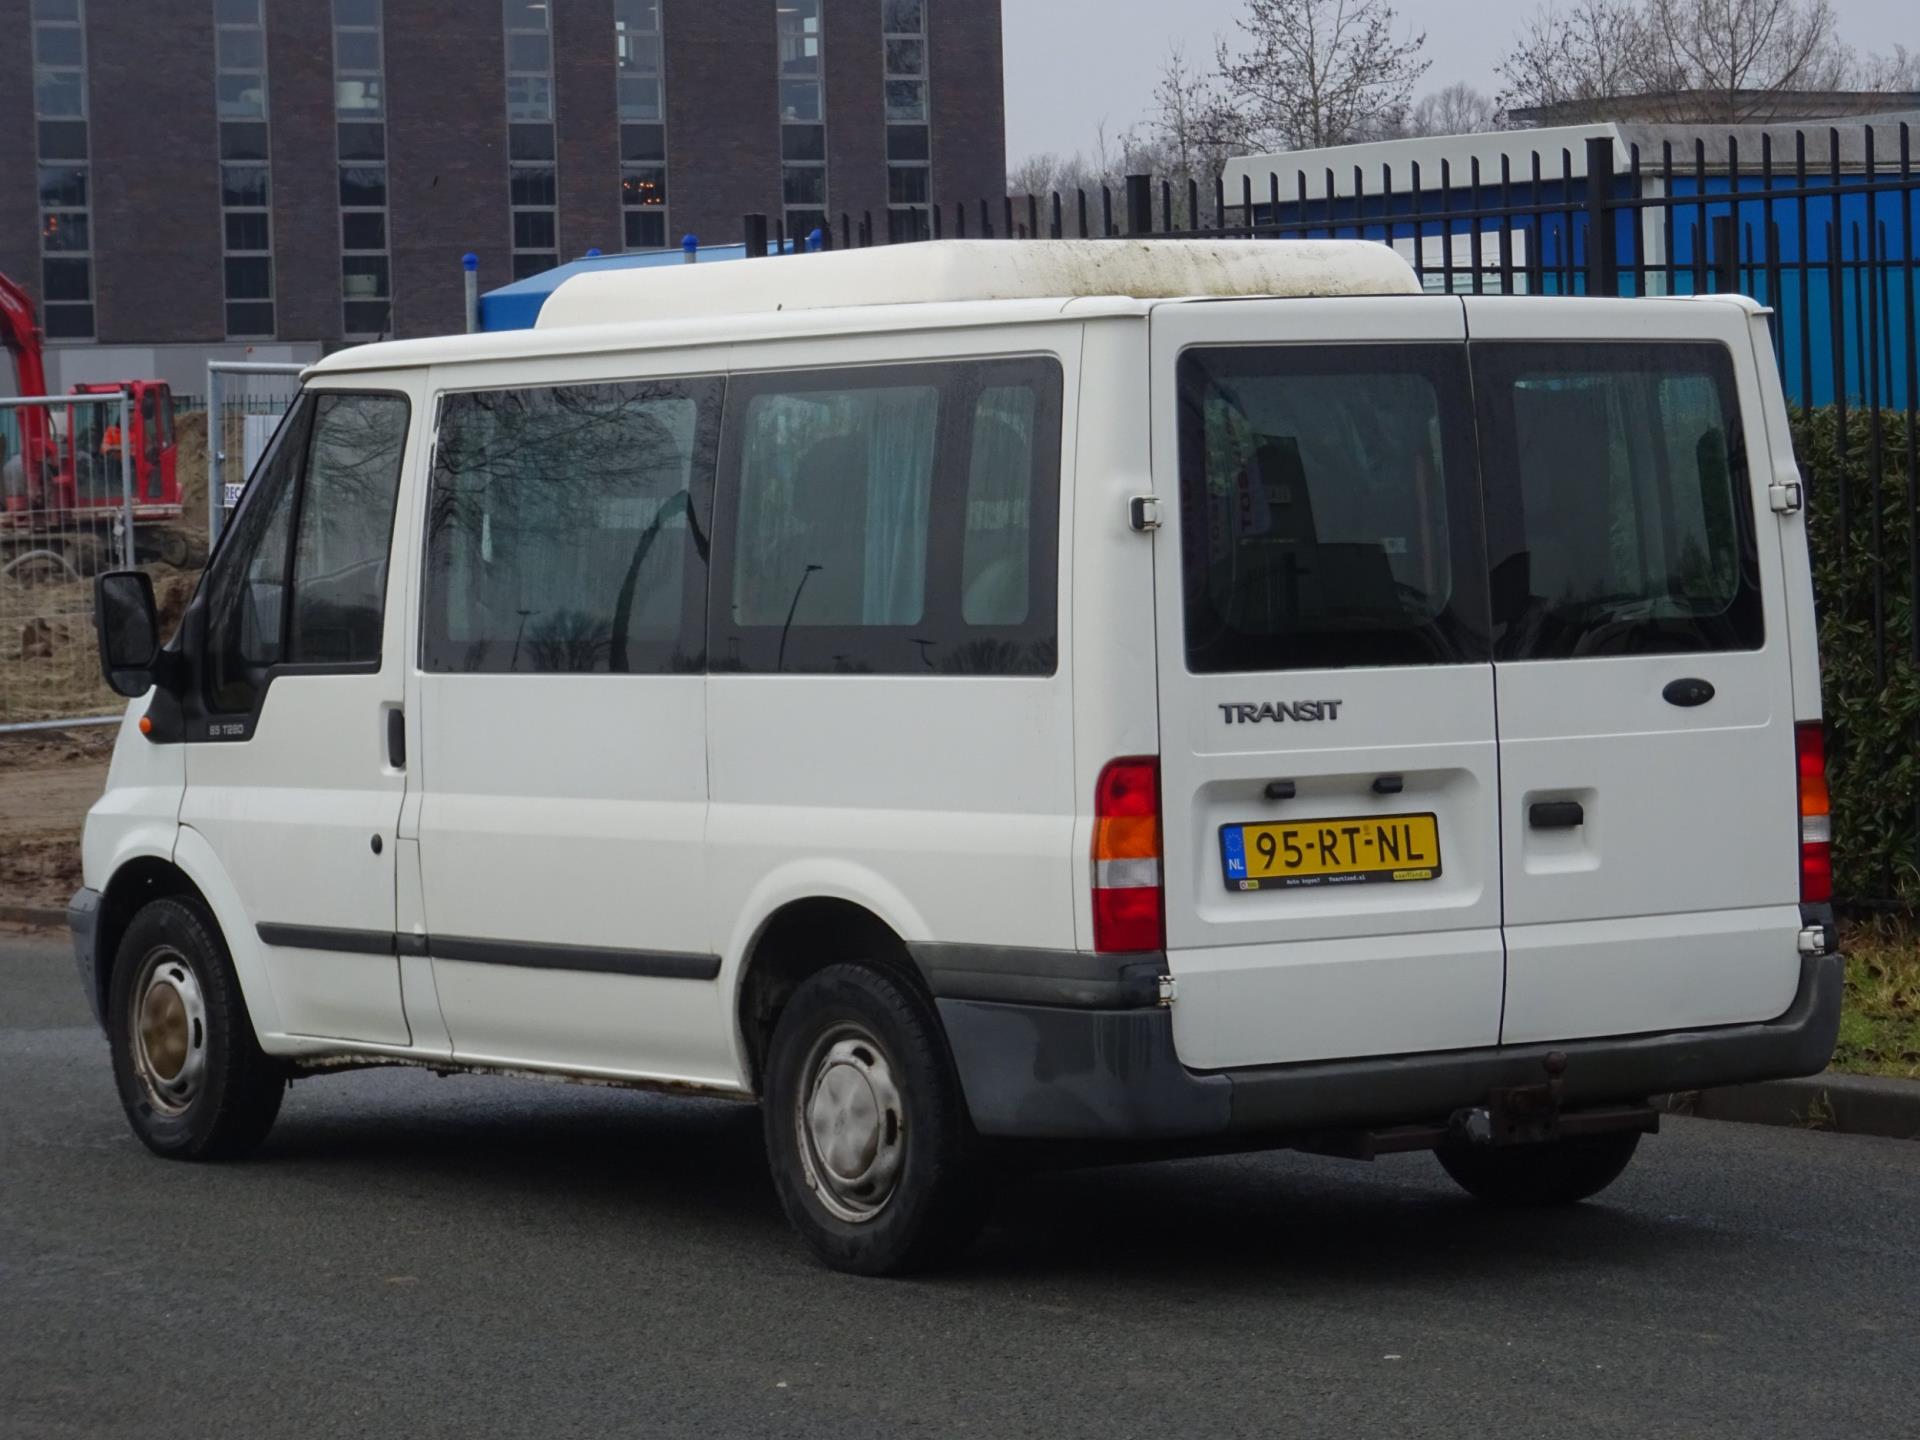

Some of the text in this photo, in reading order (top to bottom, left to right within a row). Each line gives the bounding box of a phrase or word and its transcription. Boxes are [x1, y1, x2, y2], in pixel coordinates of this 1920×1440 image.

[1217, 699, 1343, 724] TRANSIT
[1255, 824, 1424, 870] 95-RT-NL
[1228, 858, 1245, 871] NL
